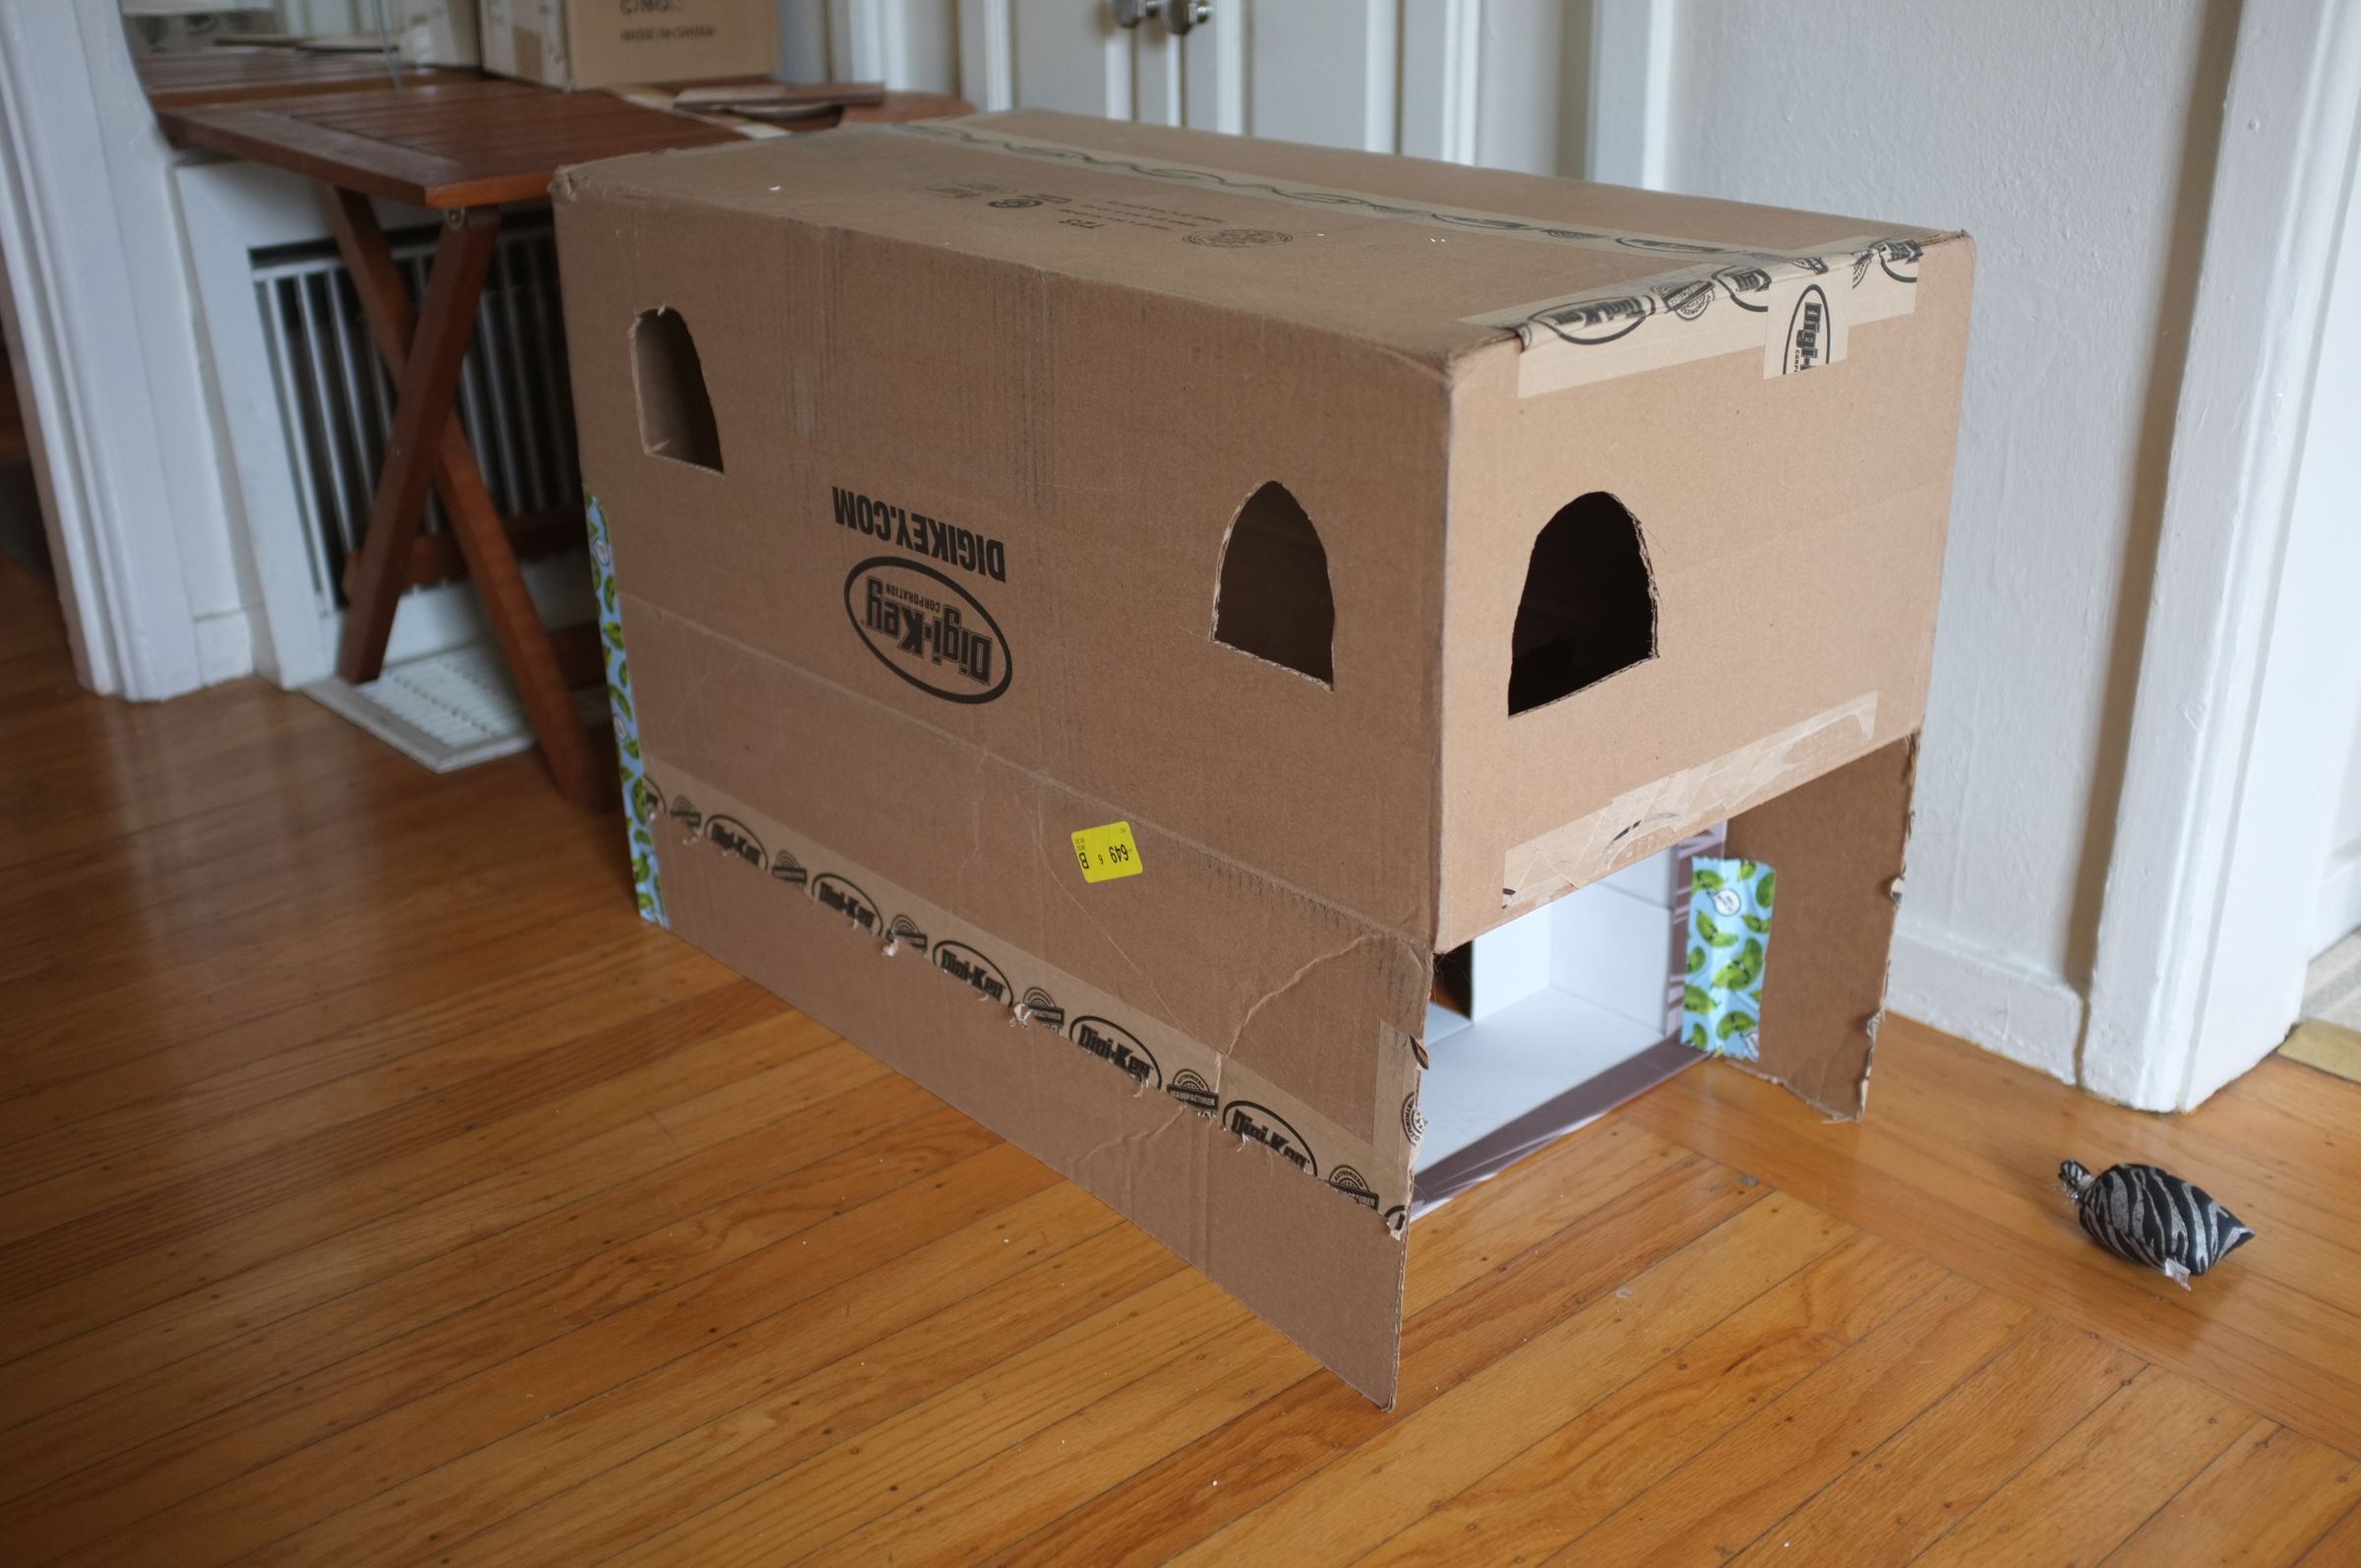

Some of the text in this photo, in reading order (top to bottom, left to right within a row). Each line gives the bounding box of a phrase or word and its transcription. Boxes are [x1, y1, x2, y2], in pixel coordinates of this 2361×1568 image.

[831, 486, 1006, 583] DIGIKEY.COM
[885, 582, 940, 614] CORPORATION
[865, 575, 993, 686] Digi-Key
[1079, 852, 1090, 870] B
[1109, 843, 1129, 864] 649
